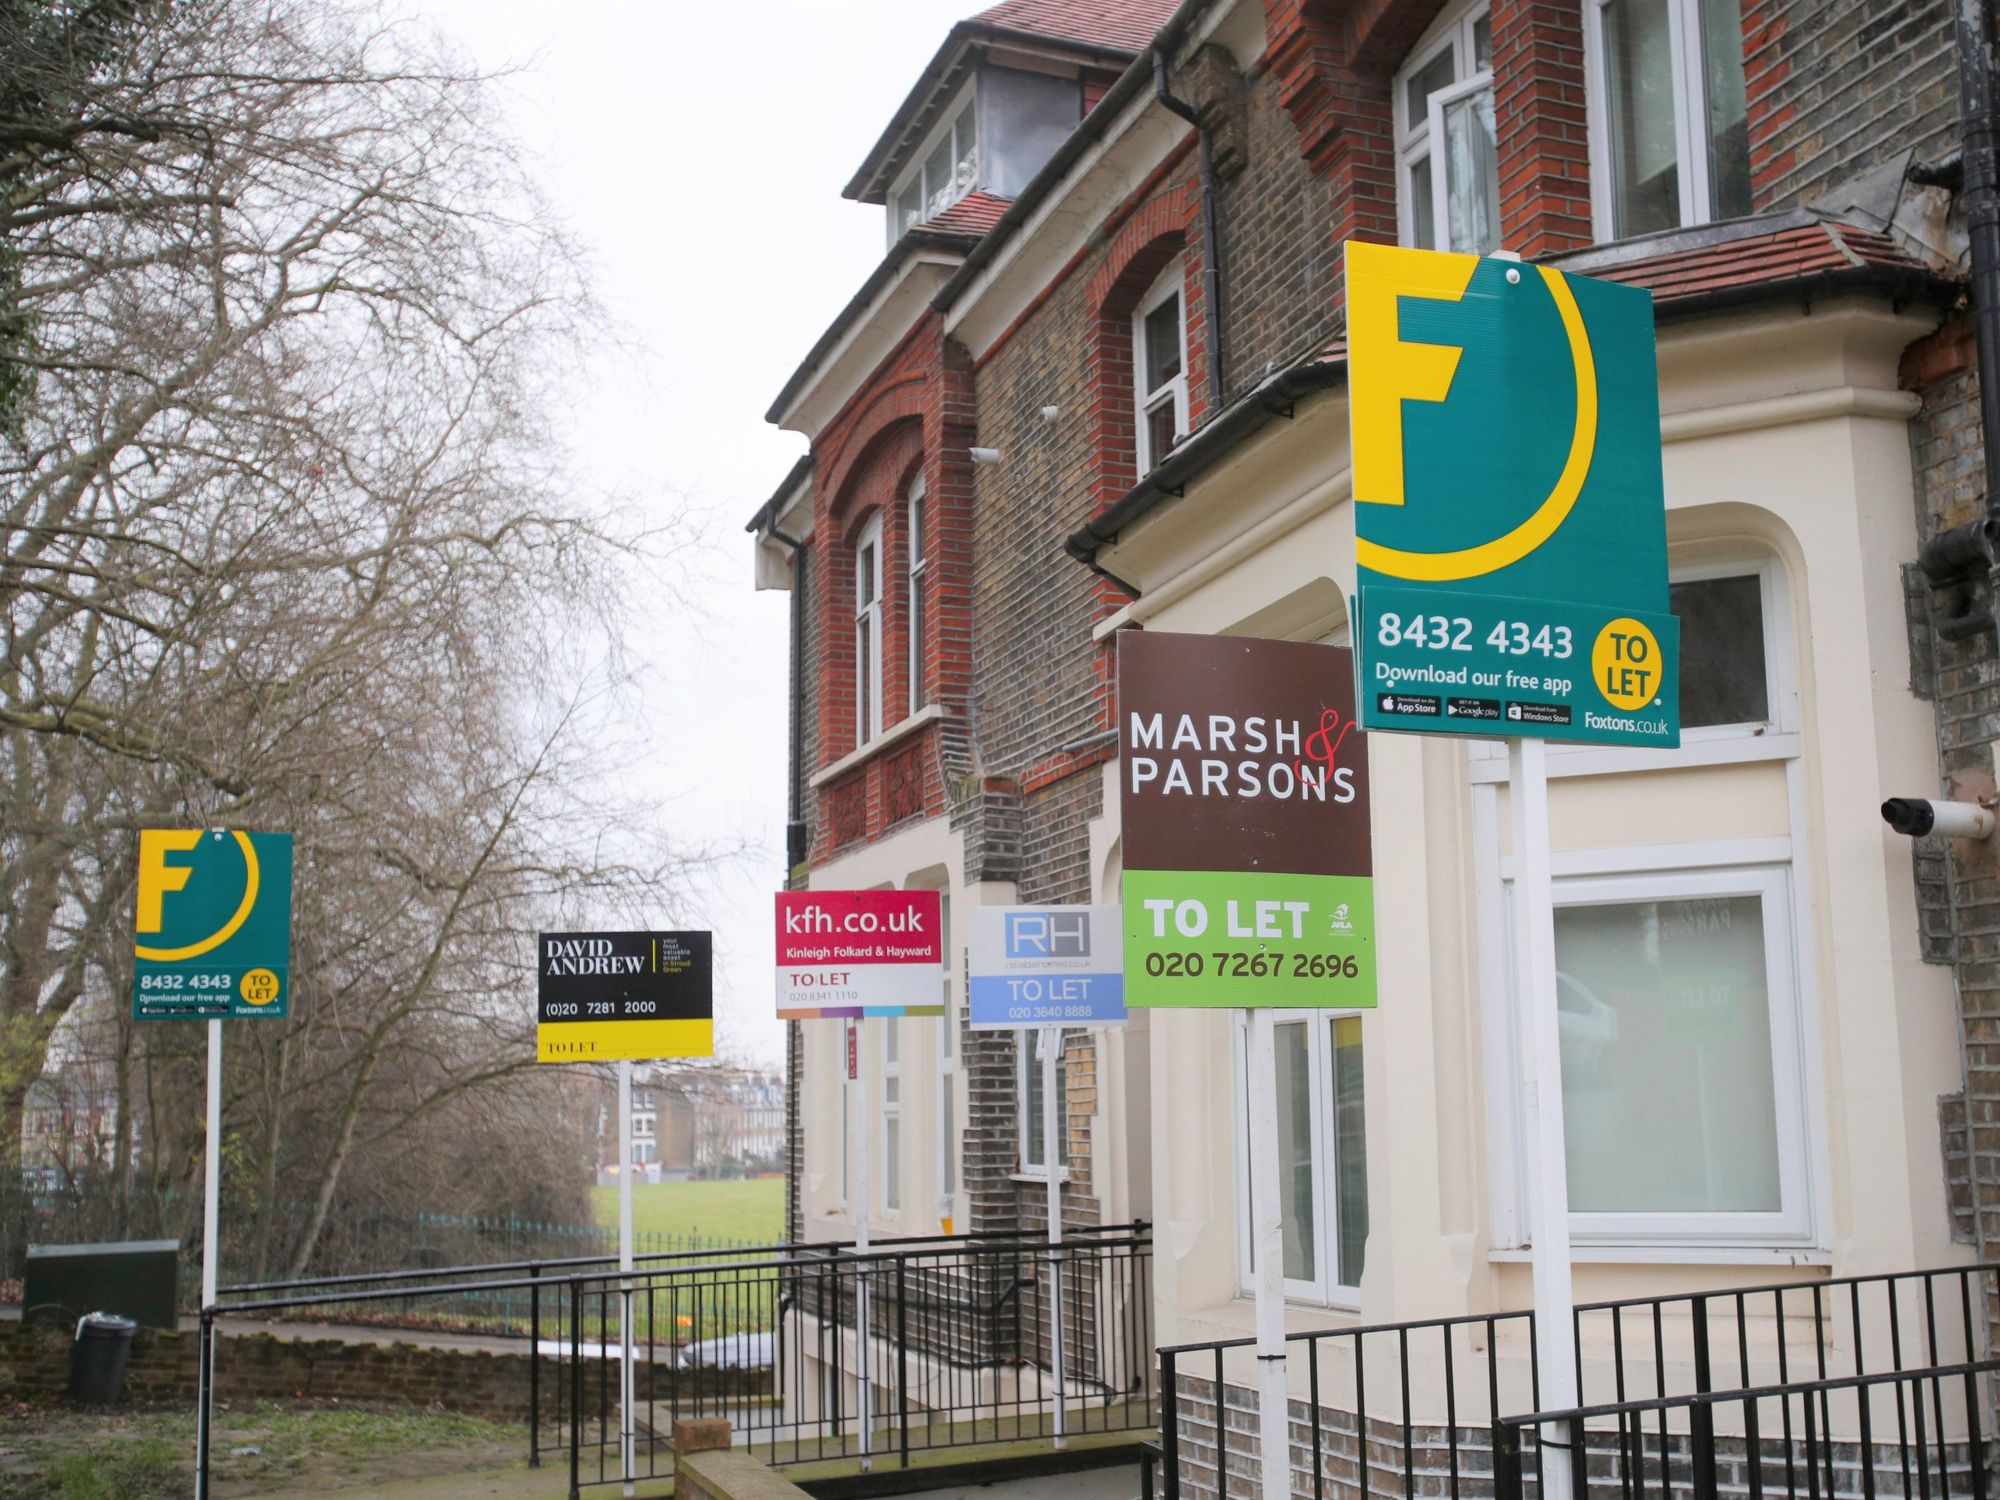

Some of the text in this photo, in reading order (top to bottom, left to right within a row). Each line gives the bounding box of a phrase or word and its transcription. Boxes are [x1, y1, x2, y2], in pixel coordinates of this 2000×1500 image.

[1378, 612, 1573, 659] 8432 4343
[1610, 632, 1648, 663] TO
[1376, 662, 1572, 697] Download our free app
[1607, 666, 1651, 698] LET
[1397, 702, 1437, 713] App Store
[1458, 706, 1499, 718] Google play
[1523, 712, 1569, 724] Windows Store
[1585, 711, 1668, 735] Foxtons.co.uk
[1131, 709, 1357, 786] MARSH &
[1131, 756, 1356, 804] PARSONS
[785, 905, 923, 934] kfh.co.uk
[1143, 899, 1310, 938] TO LET
[1013, 917, 1084, 952] RH
[547, 939, 613, 958] DAVID
[786, 945, 931, 960] Kinleigh Folkard & Hayward
[546, 956, 645, 976] ANDREW
[1145, 952, 1359, 978] 020 7267 2696
[140, 974, 232, 989] 8432 4343
[250, 974, 271, 987] TO
[790, 972, 850, 987] TO LET
[139, 993, 230, 1004] Download our free app
[248, 989, 272, 1000] LET
[789, 991, 858, 1001] 020 8341 1110
[1007, 979, 1092, 1001] TO LET
[546, 1001, 656, 1017] (0)20 7281 2000
[1009, 1007, 1031, 1018] 020
[1065, 1006, 1092, 1017] 8888
[546, 1041, 598, 1053] TO LET
